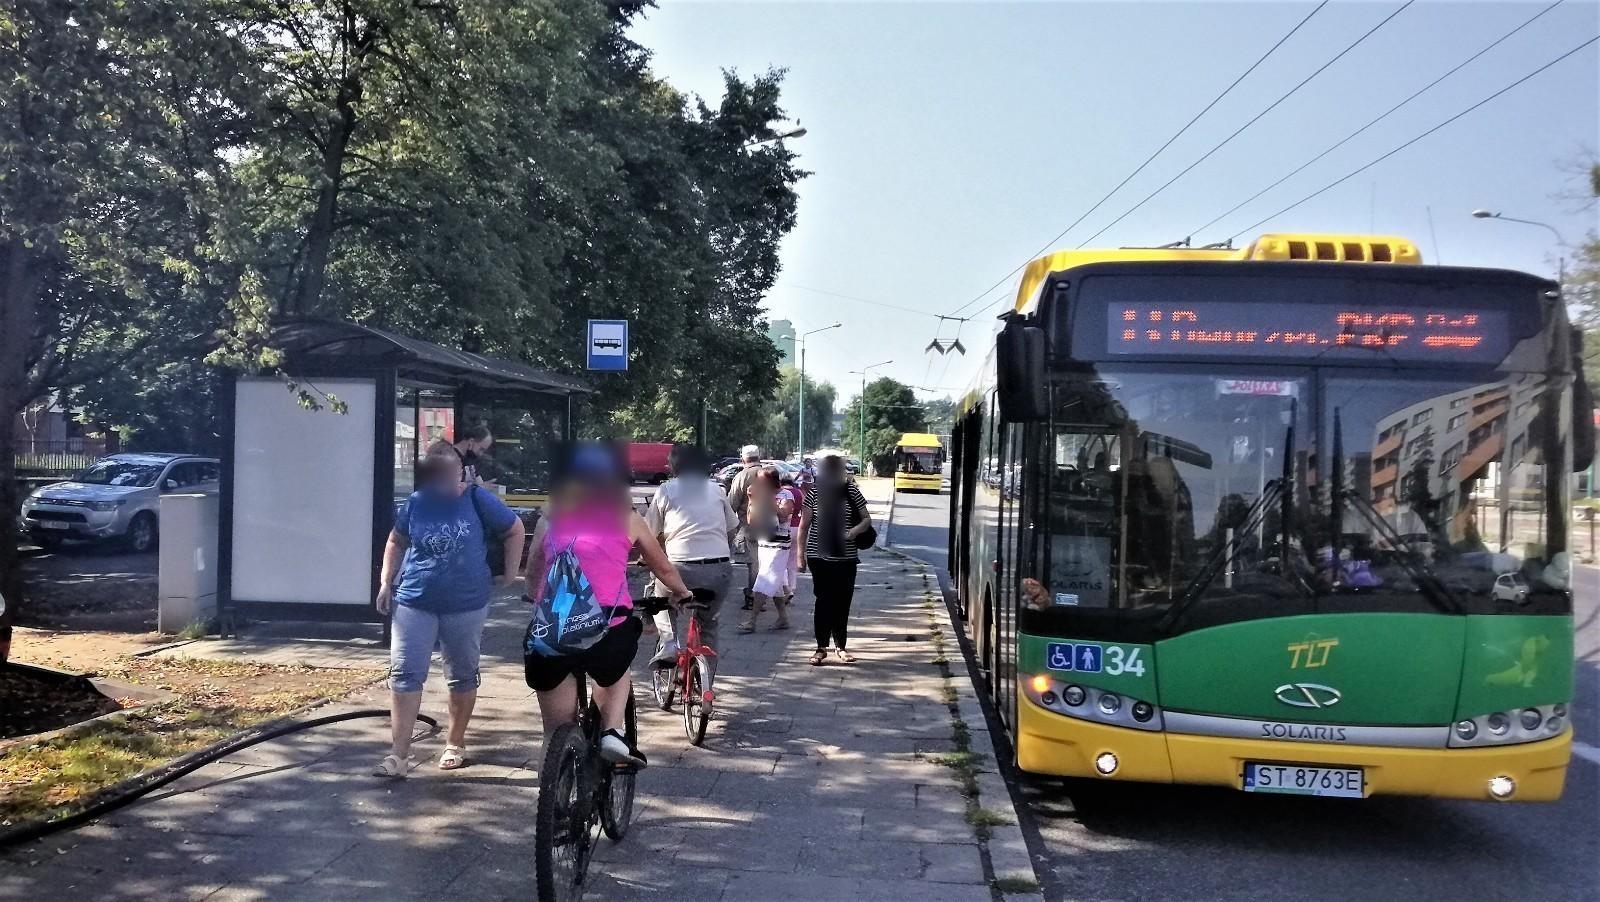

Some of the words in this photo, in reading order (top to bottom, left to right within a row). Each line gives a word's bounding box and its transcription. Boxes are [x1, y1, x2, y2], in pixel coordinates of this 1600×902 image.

[1104, 645, 1146, 677] 34
[1287, 638, 1340, 669] TLT
[1261, 723, 1347, 741] SOLARIS
[1258, 766, 1288, 787] ST
[1294, 768, 1360, 792] 8763E
